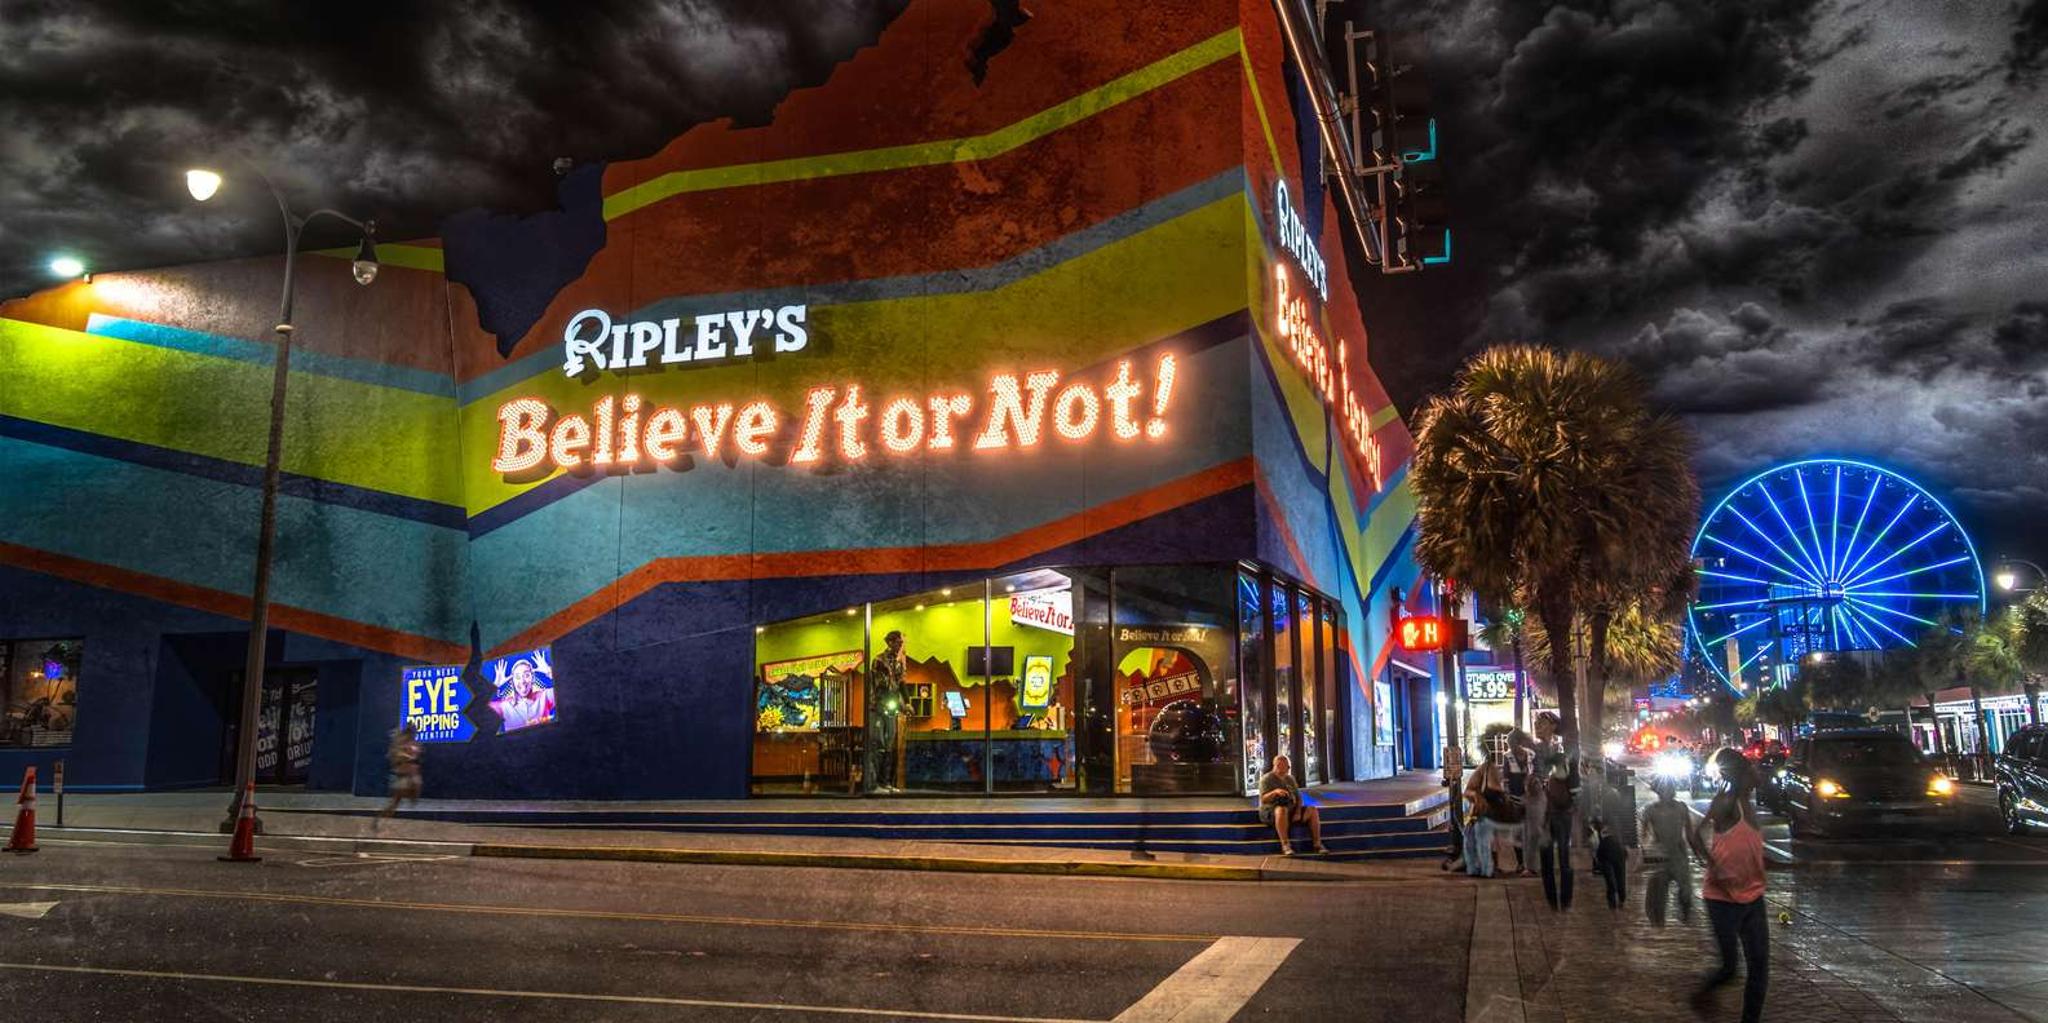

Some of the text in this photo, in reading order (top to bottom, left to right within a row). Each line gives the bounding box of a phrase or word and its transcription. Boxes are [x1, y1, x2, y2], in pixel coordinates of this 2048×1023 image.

[1277, 179, 1328, 302] RIPLEY'S
[563, 304, 808, 377] RIPLEY'S
[493, 351, 1177, 473] Believe It or Not!
[1010, 597, 1045, 623] Believe
[1056, 612, 1070, 629] or
[1120, 628, 1159, 641] Believe
[408, 675, 459, 715] EYE
[1466, 672, 1516, 682] OTHING OVE
[415, 730, 454, 741] VENTURE
